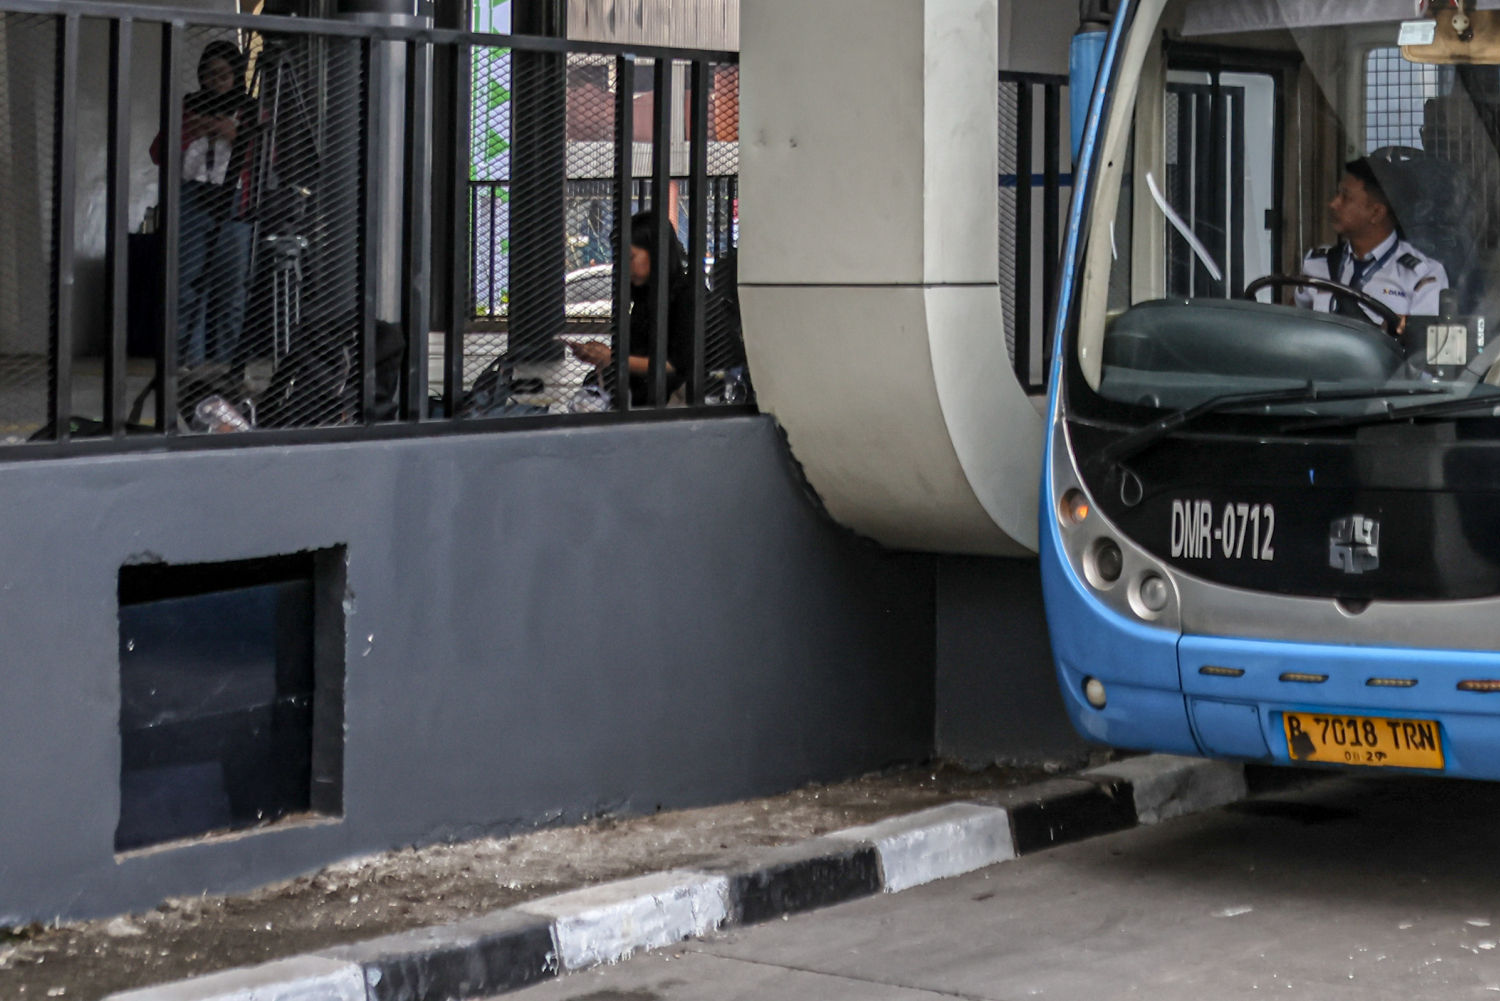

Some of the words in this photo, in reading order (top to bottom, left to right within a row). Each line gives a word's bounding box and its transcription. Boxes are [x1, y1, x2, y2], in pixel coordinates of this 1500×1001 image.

[1170, 499, 1276, 562] DMR-0712
[1313, 716, 1378, 748] 7018
[1385, 719, 1437, 752] TRN
